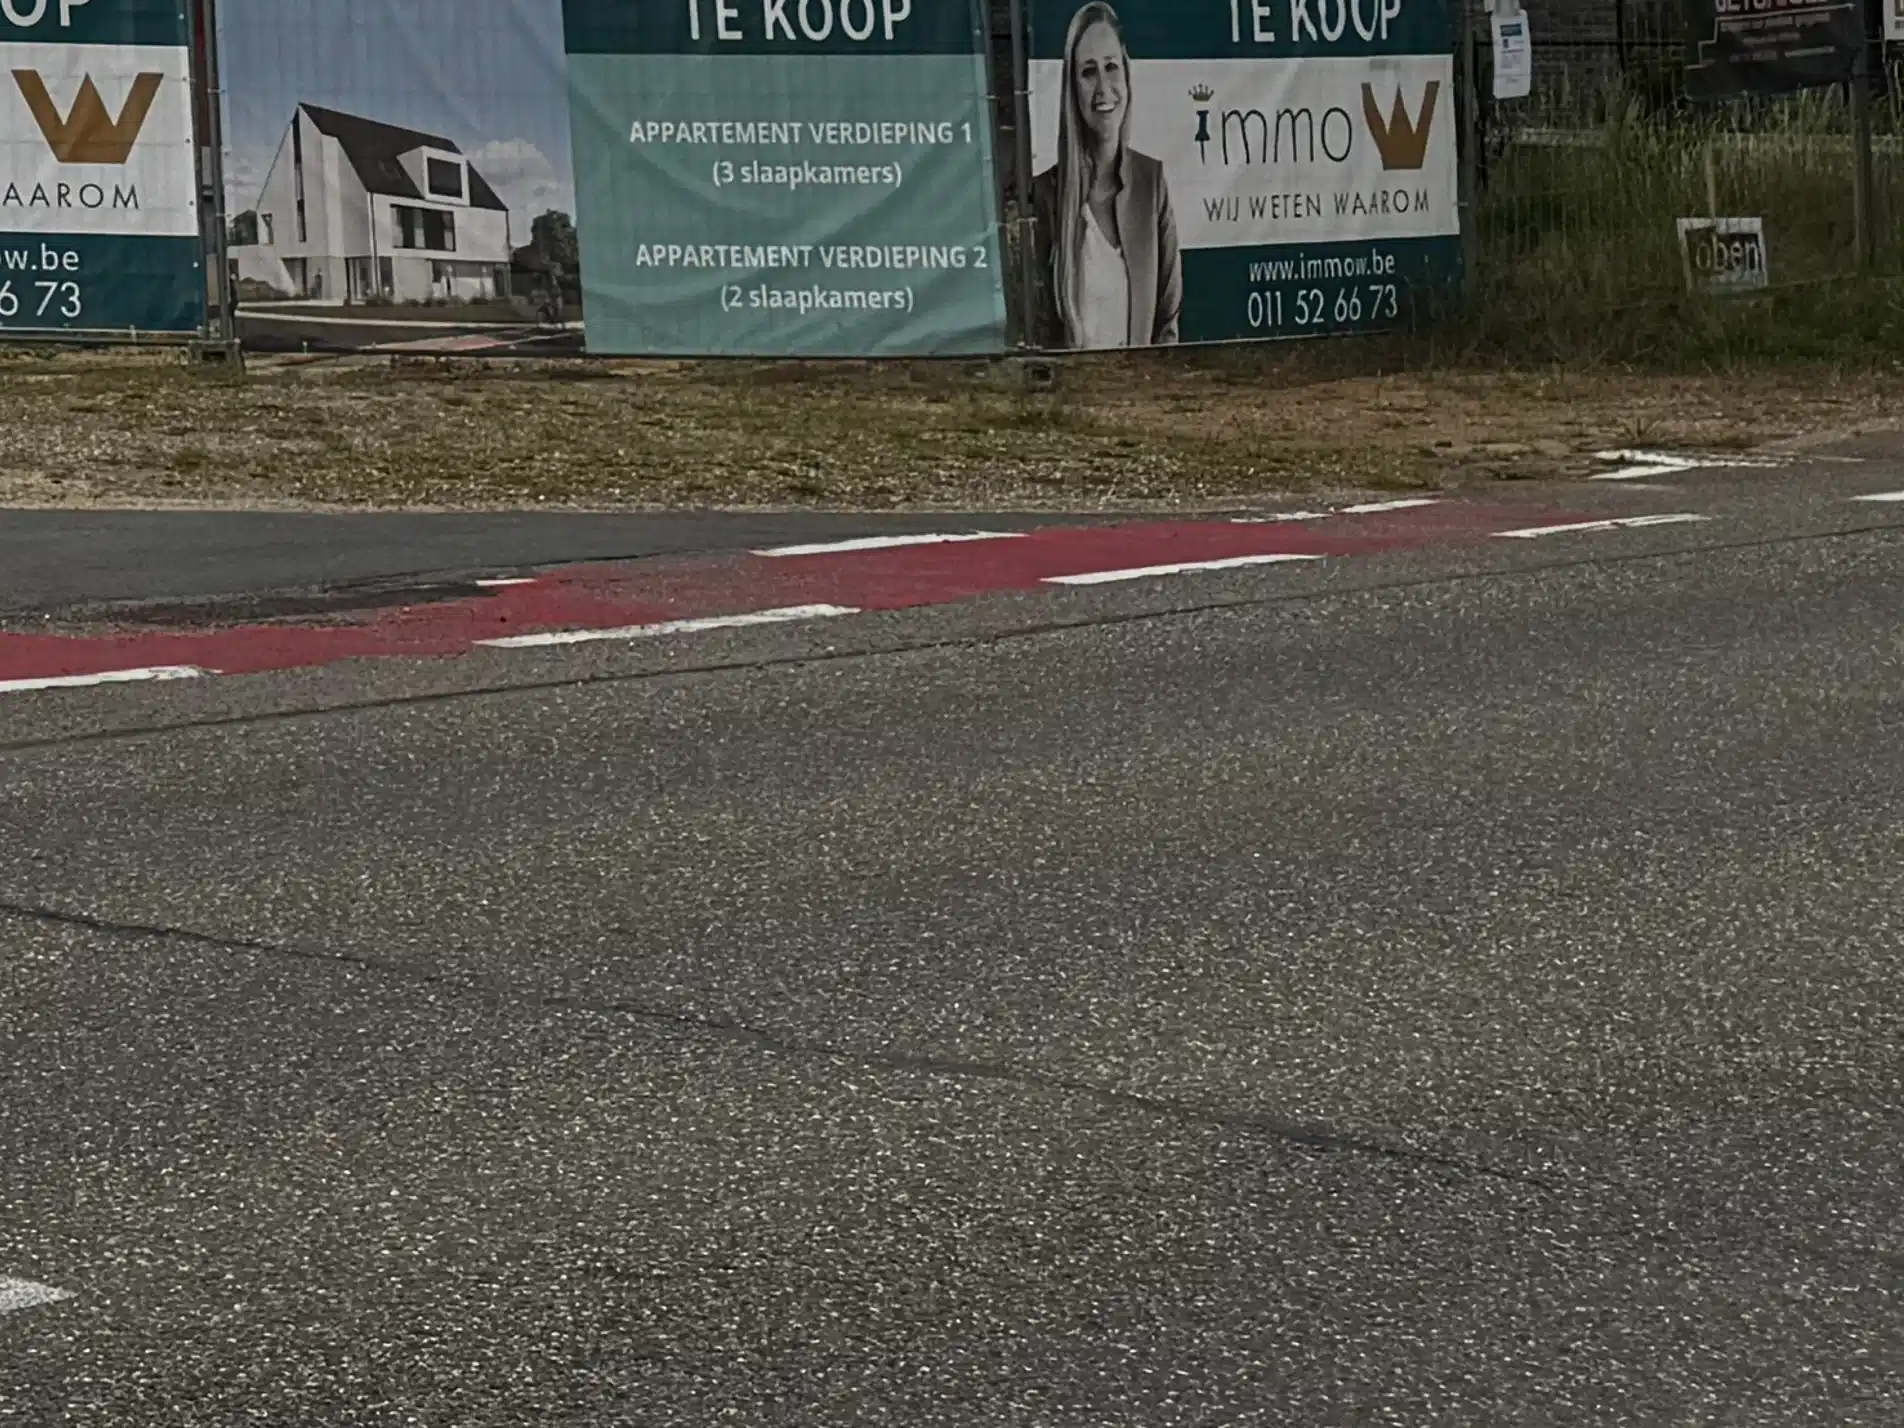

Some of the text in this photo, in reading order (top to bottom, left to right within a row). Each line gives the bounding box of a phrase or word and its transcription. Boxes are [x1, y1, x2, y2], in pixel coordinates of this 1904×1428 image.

[629, 120, 973, 145] APPARTEMENT VERDIEPING 1
[711, 160, 903, 190] (3 slaapkamers)
[1203, 188, 1430, 222] WIJ WETEN WAAROM
[635, 243, 988, 269] APPARTEMENT VERDIEPING 2
[1248, 247, 1397, 283] www.immow.be
[34, 280, 83, 318] 73
[720, 284, 915, 315] (2 slaapkamers)
[1247, 283, 1399, 328] 011 52 66 73
